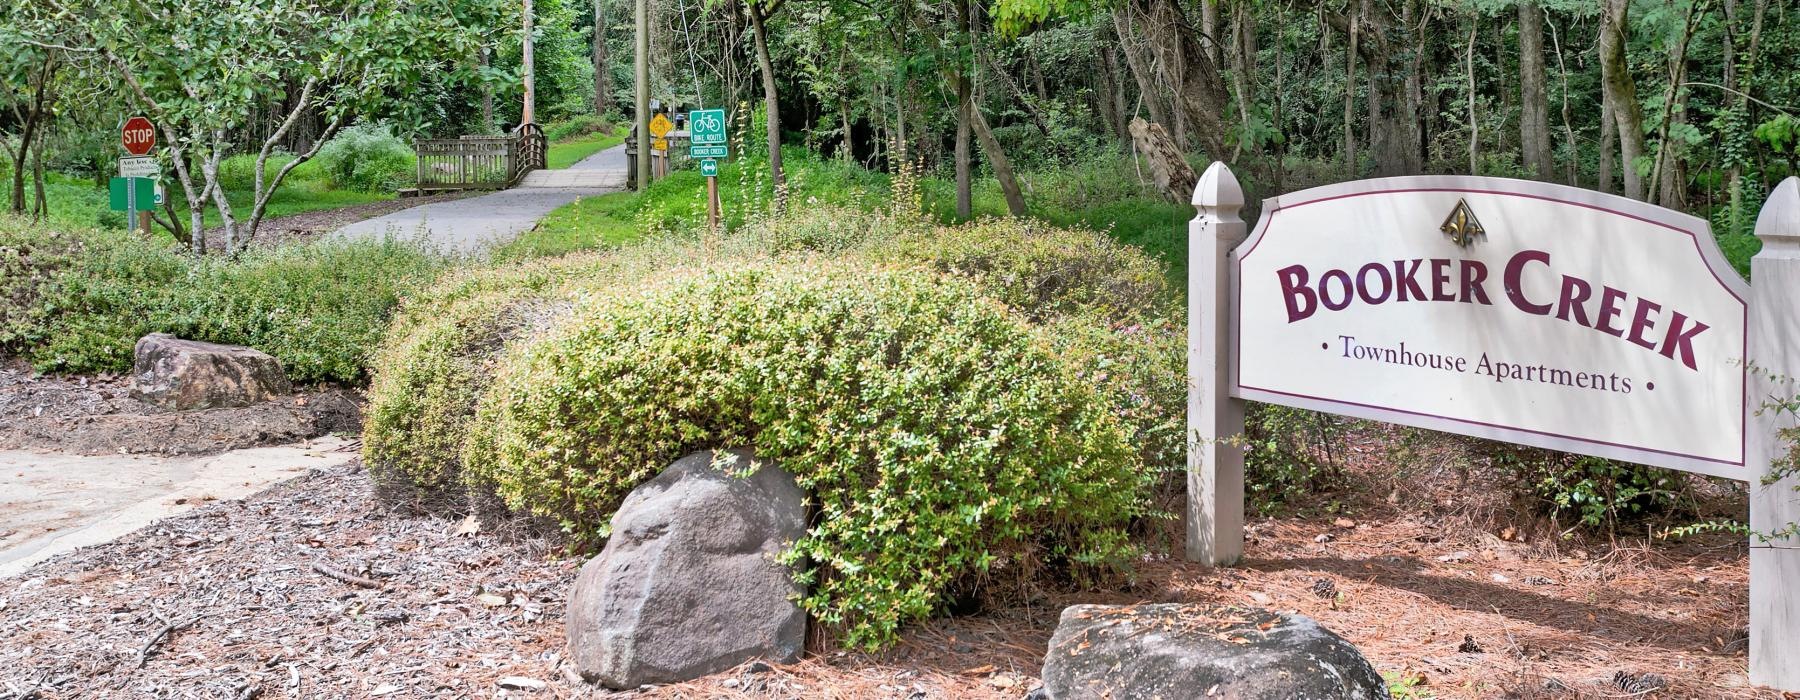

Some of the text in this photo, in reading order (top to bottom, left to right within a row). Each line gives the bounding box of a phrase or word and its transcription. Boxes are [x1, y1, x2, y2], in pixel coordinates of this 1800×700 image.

[124, 129, 153, 144] STOP
[1276, 250, 1711, 372] BOOKER CREEK
[1338, 335, 1633, 394] Townhouse Apartments
